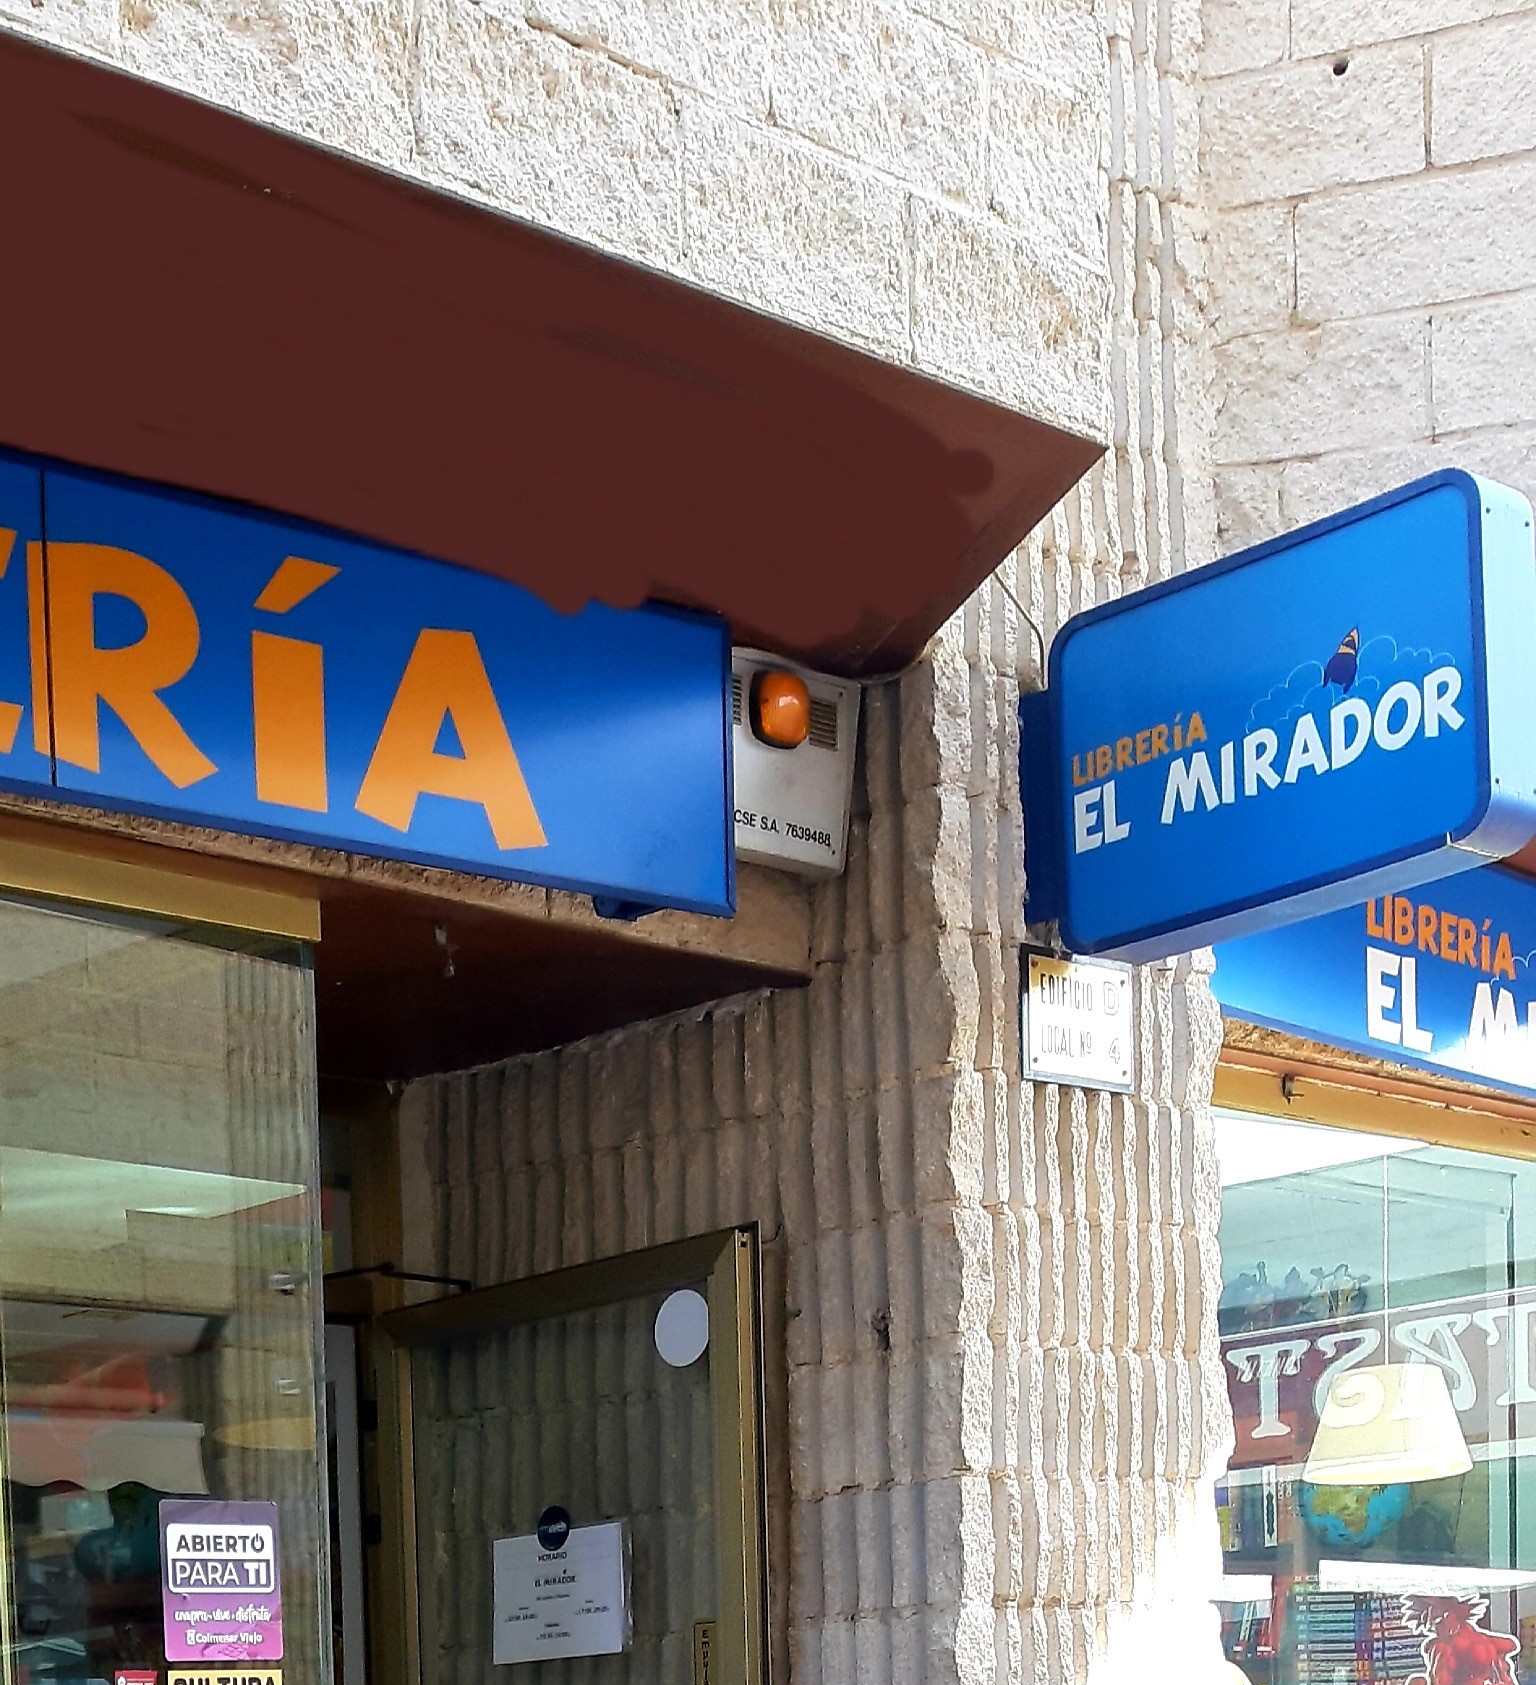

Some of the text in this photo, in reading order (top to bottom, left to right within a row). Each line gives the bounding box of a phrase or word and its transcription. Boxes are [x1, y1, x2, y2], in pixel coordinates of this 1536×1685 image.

[1074, 664, 1464, 855] EL MIRADOR
[785, 822, 831, 847] 7639488
[1040, 973, 1093, 1011] EDIFICIO
[1366, 945, 1434, 1054] EL
[1041, 1024, 1074, 1058] LOCAL
[1109, 1038, 1121, 1063] 4
[176, 1533, 265, 1553] ABIERTO
[175, 1562, 267, 1586] PARA TI
